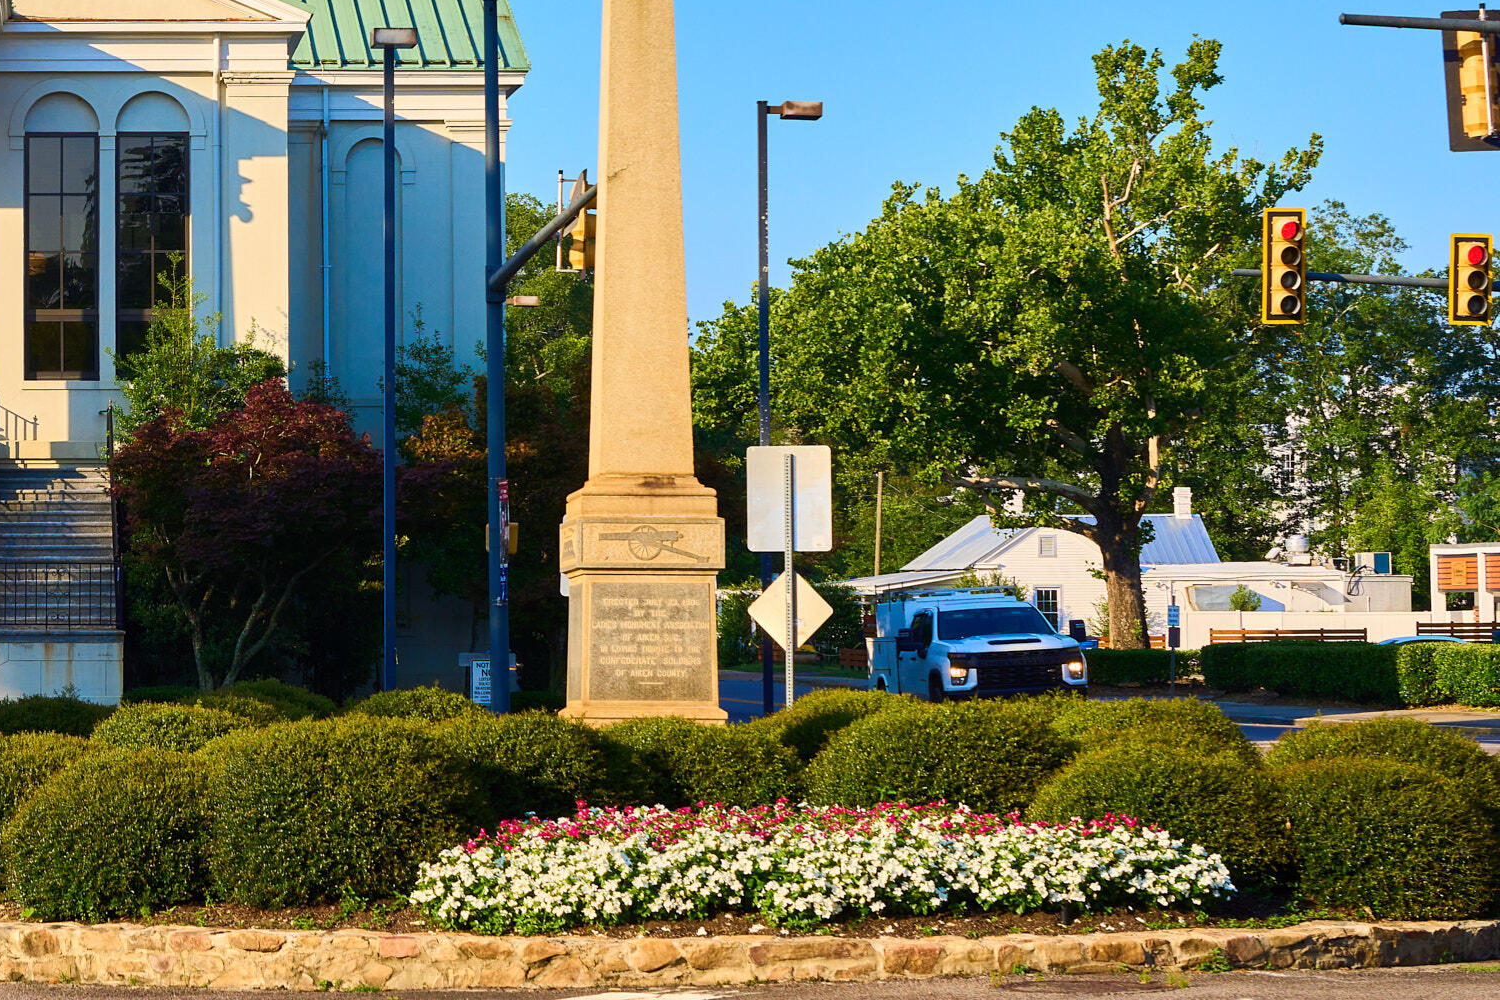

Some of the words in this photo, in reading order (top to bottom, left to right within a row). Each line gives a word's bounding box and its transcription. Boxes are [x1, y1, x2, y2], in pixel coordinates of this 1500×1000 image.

[602, 598, 639, 606] ERECTED
[644, 598, 662, 606] JULY
[634, 609, 646, 617] BY
[650, 609, 667, 617] THE
[620, 621, 660, 629] MONUMENT
[664, 621, 709, 629] ASSOCIATION
[622, 633, 632, 641] OF
[600, 656, 656, 665] CONFEDERATE
[663, 656, 702, 665] SOLDIERS
[616, 669, 626, 677] OF
[630, 669, 652, 677] AIKEN
